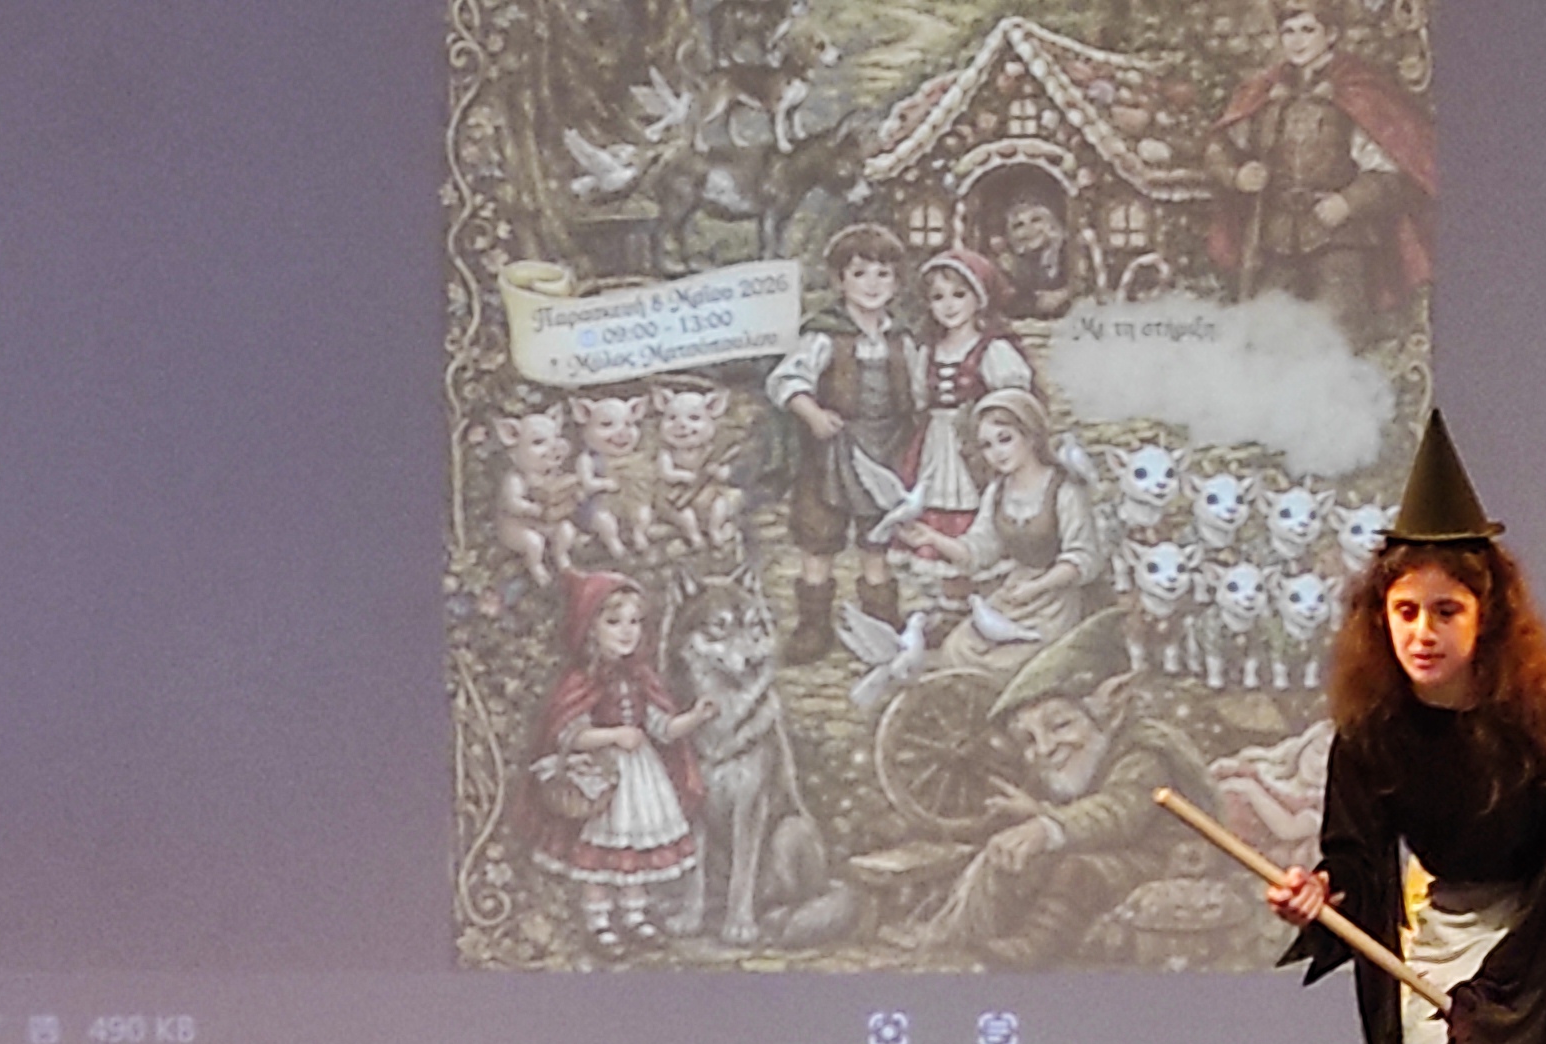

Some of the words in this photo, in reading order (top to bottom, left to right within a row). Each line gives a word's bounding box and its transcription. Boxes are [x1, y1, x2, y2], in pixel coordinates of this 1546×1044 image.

[738, 274, 790, 298] 2026
[88, 1014, 146, 1043] 490
[155, 1015, 196, 1043] KB
